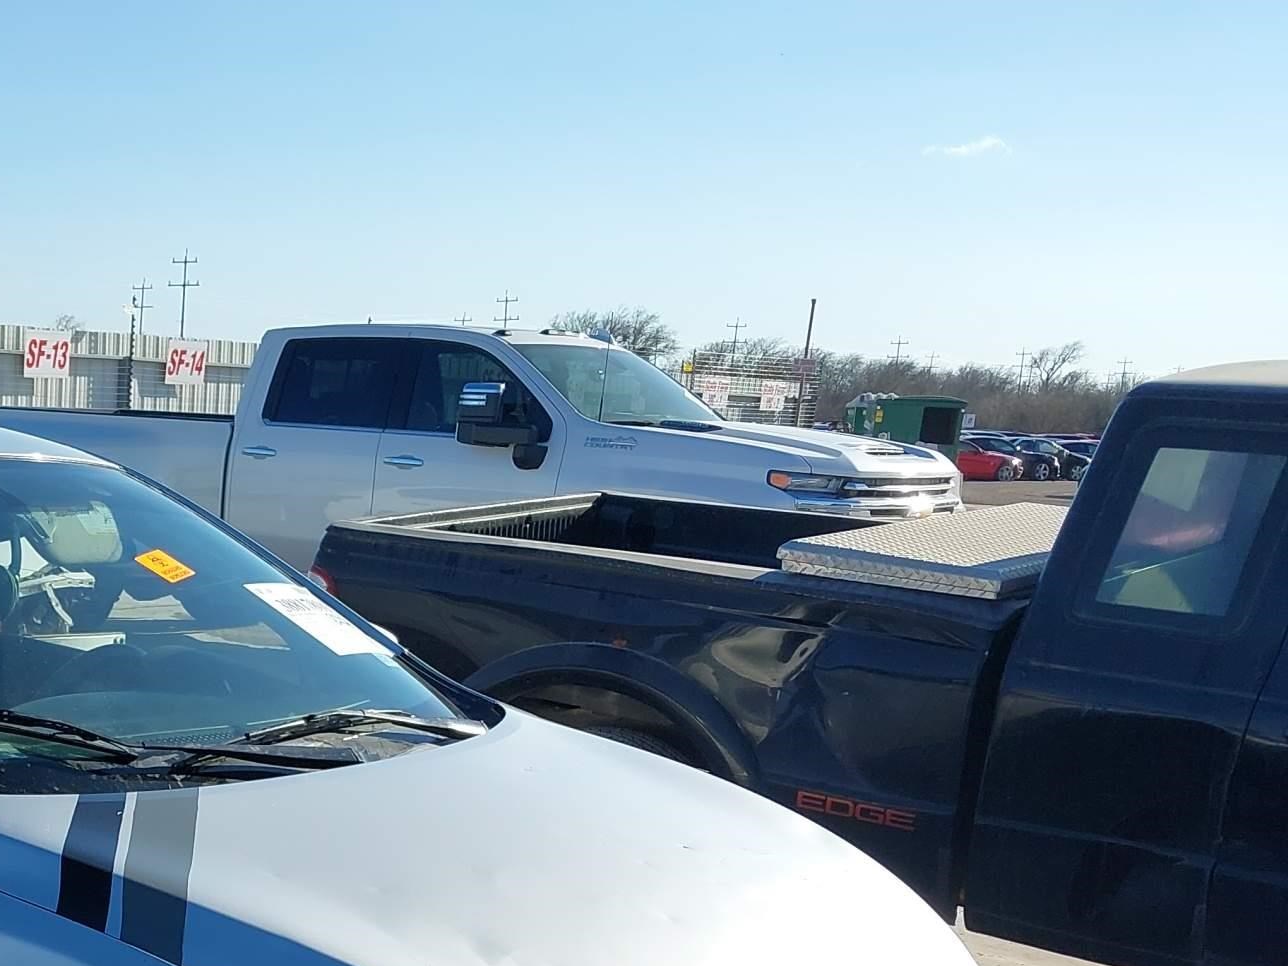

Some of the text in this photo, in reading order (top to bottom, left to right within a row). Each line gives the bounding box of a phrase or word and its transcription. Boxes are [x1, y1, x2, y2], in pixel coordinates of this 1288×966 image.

[26, 338, 69, 370] SF-13
[167, 349, 205, 376] SF-14
[796, 790, 917, 832] EDGE
